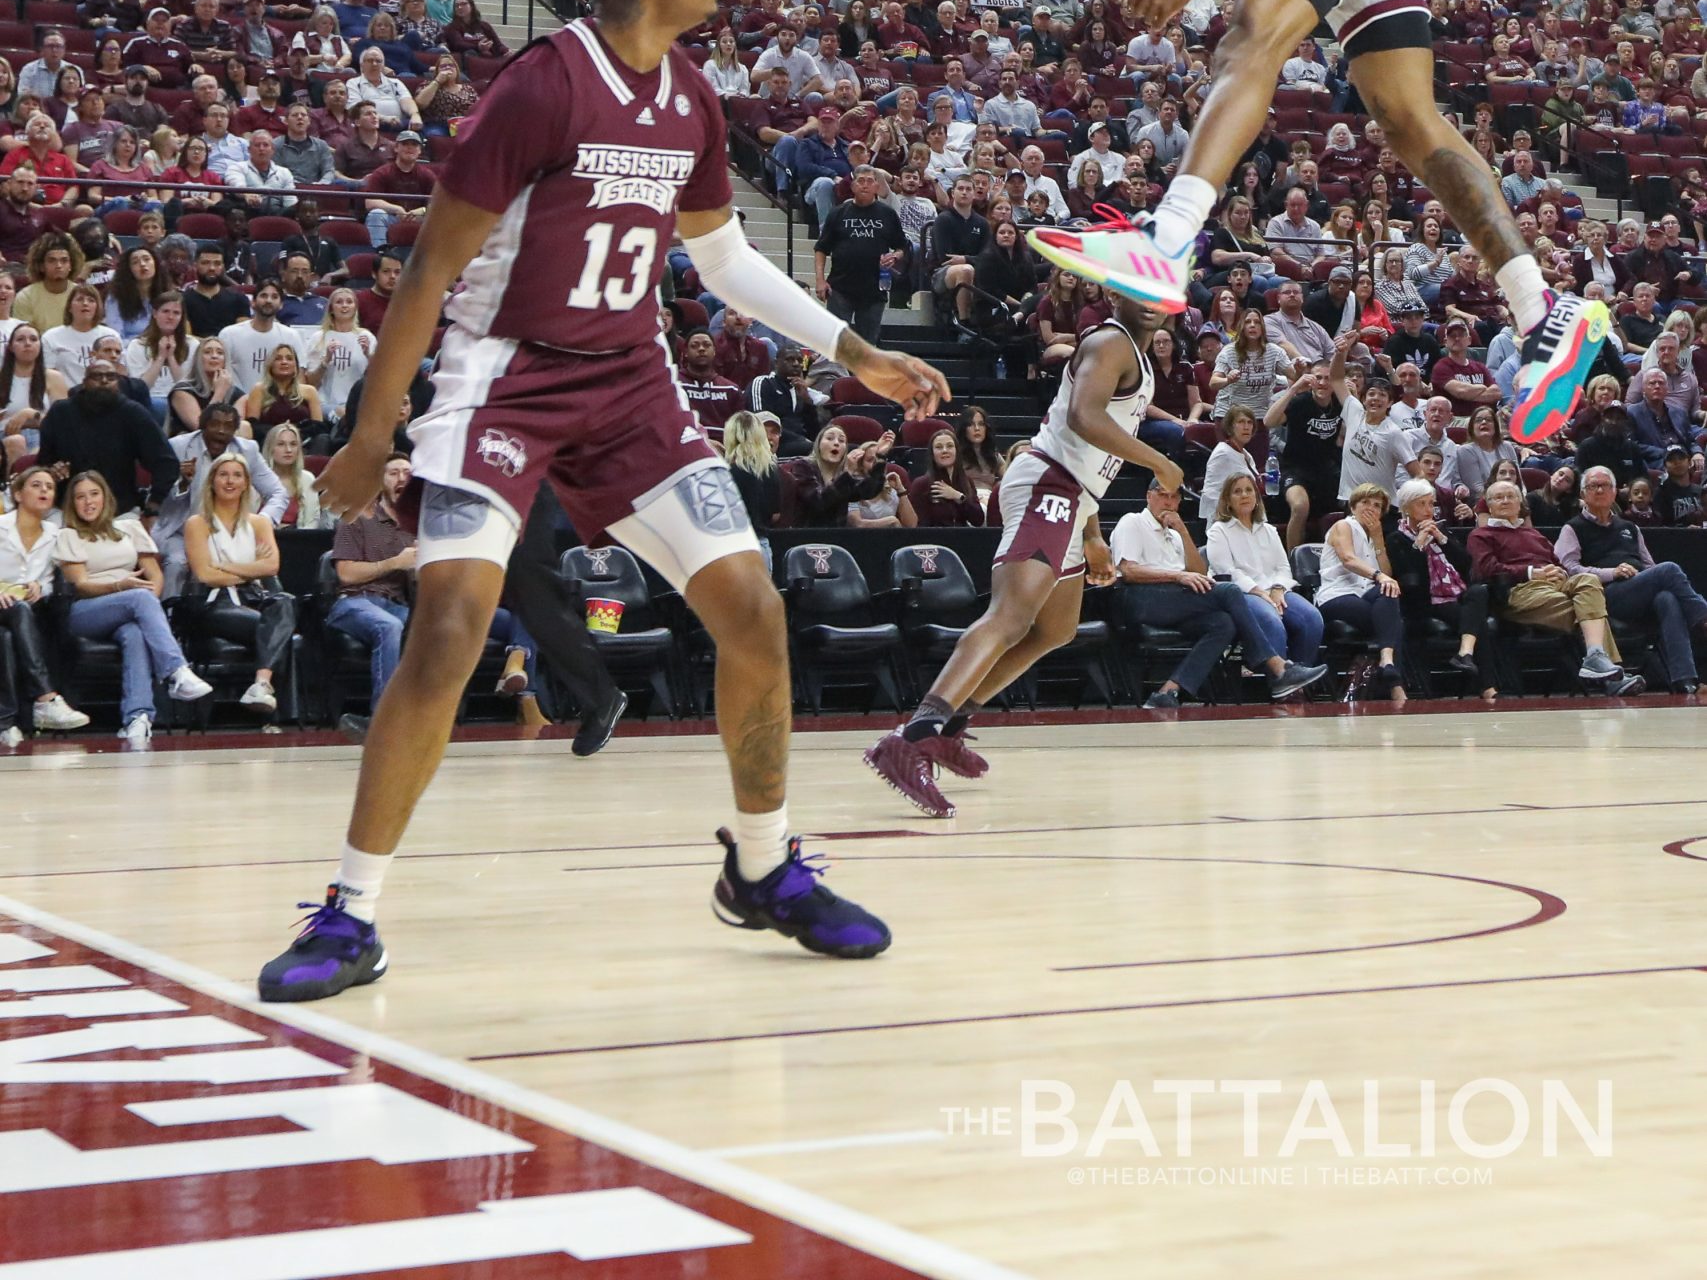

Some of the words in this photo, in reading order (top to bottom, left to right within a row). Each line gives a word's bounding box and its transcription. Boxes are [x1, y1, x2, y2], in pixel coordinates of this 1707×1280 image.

[608, 182, 662, 207] STATE
[843, 218, 883, 229] TEXAS
[850, 228, 874, 238] A&M
[567, 222, 657, 311] 13
